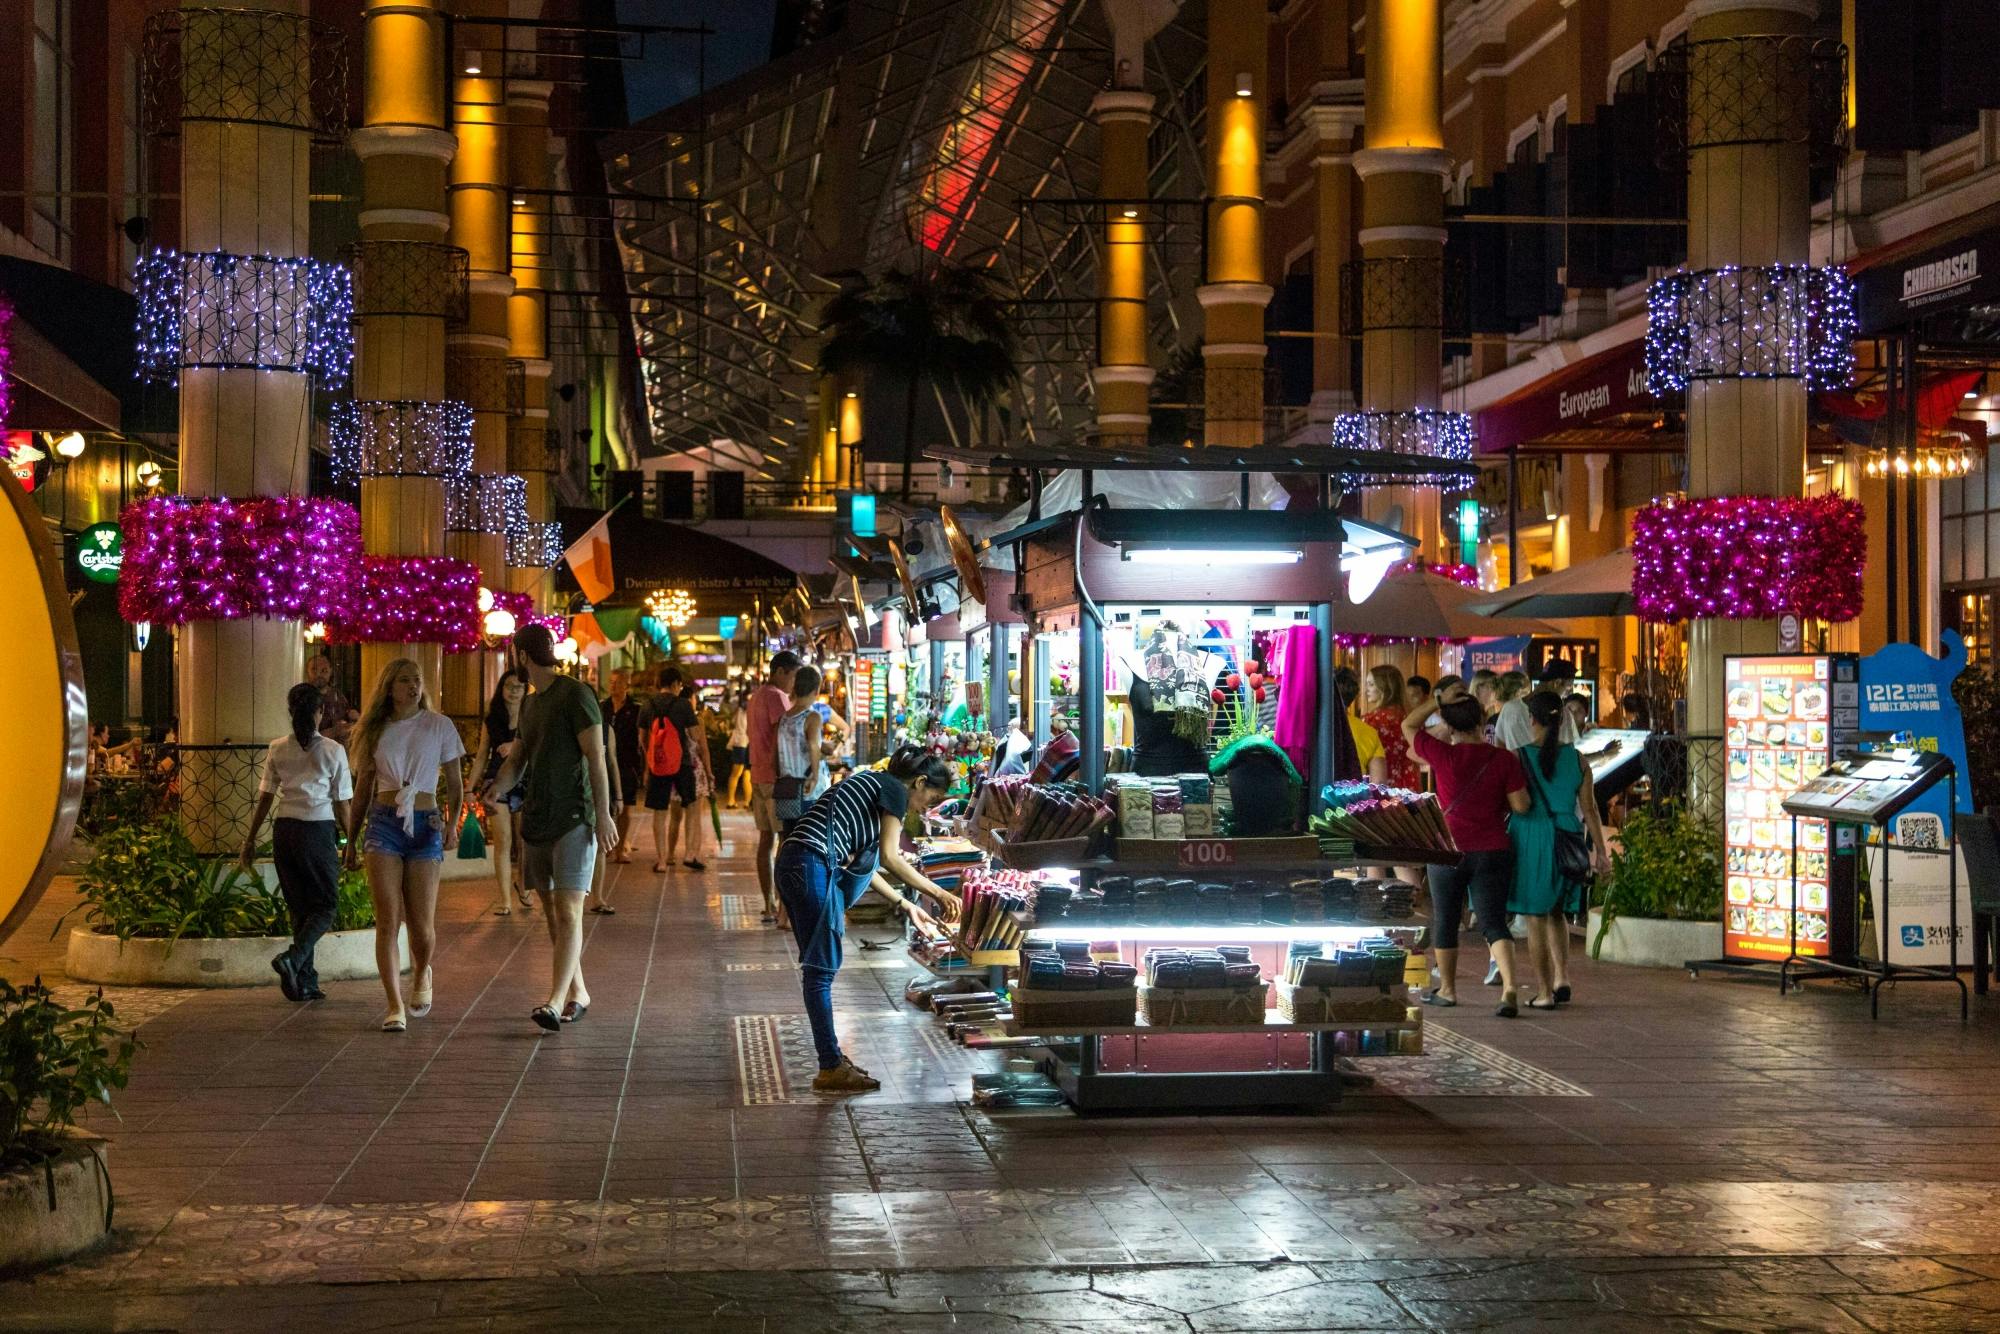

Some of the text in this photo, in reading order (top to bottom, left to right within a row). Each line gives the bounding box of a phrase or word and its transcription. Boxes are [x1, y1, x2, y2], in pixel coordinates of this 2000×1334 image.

[1904, 249, 1977, 298] CHURRASCO
[1560, 384, 1610, 419] European
[700, 577, 730, 588] bistro
[732, 577, 742, 587] &
[745, 577, 771, 587] wine
[774, 576, 790, 587] bar
[1866, 684, 1905, 701] 1212
